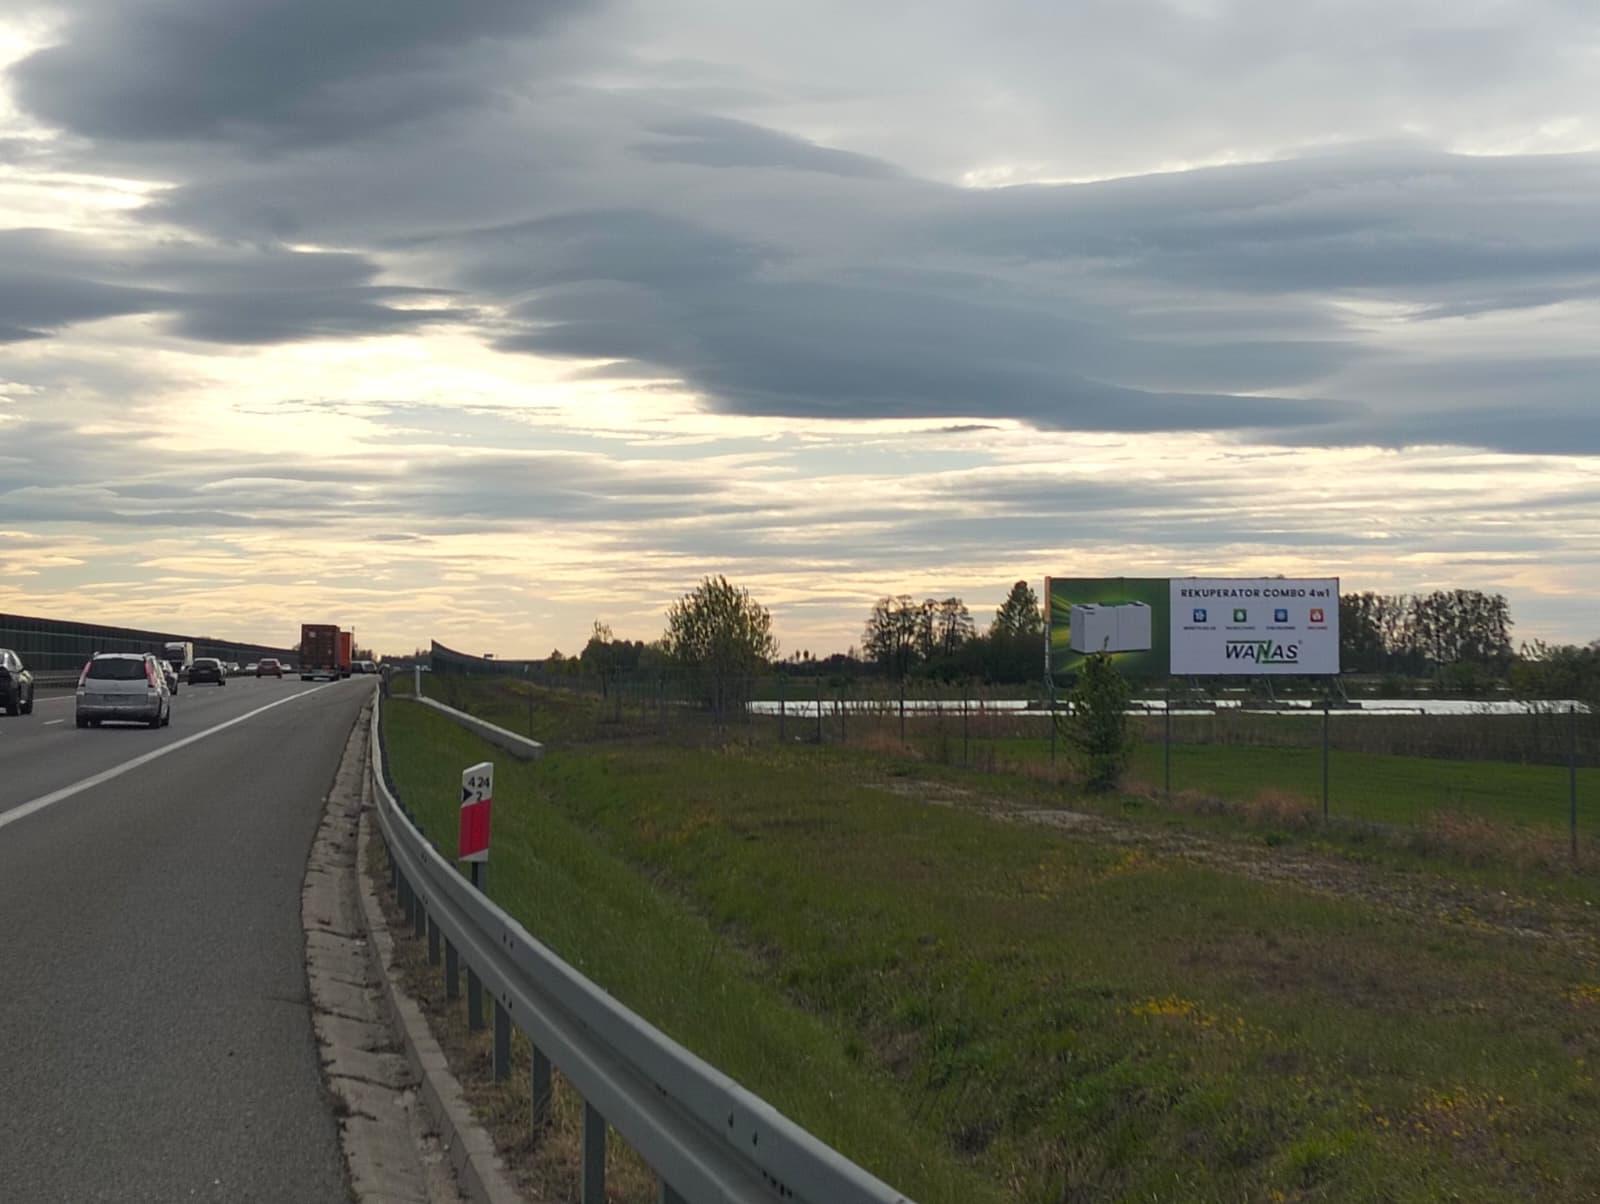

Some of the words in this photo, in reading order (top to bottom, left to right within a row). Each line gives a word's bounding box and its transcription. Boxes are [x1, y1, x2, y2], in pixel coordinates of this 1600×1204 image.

[1181, 588, 1260, 598] REKUPERATOR
[1263, 588, 1306, 598] COMBO
[1309, 588, 1330, 598] 4w1
[1225, 640, 1299, 664] WANAS
